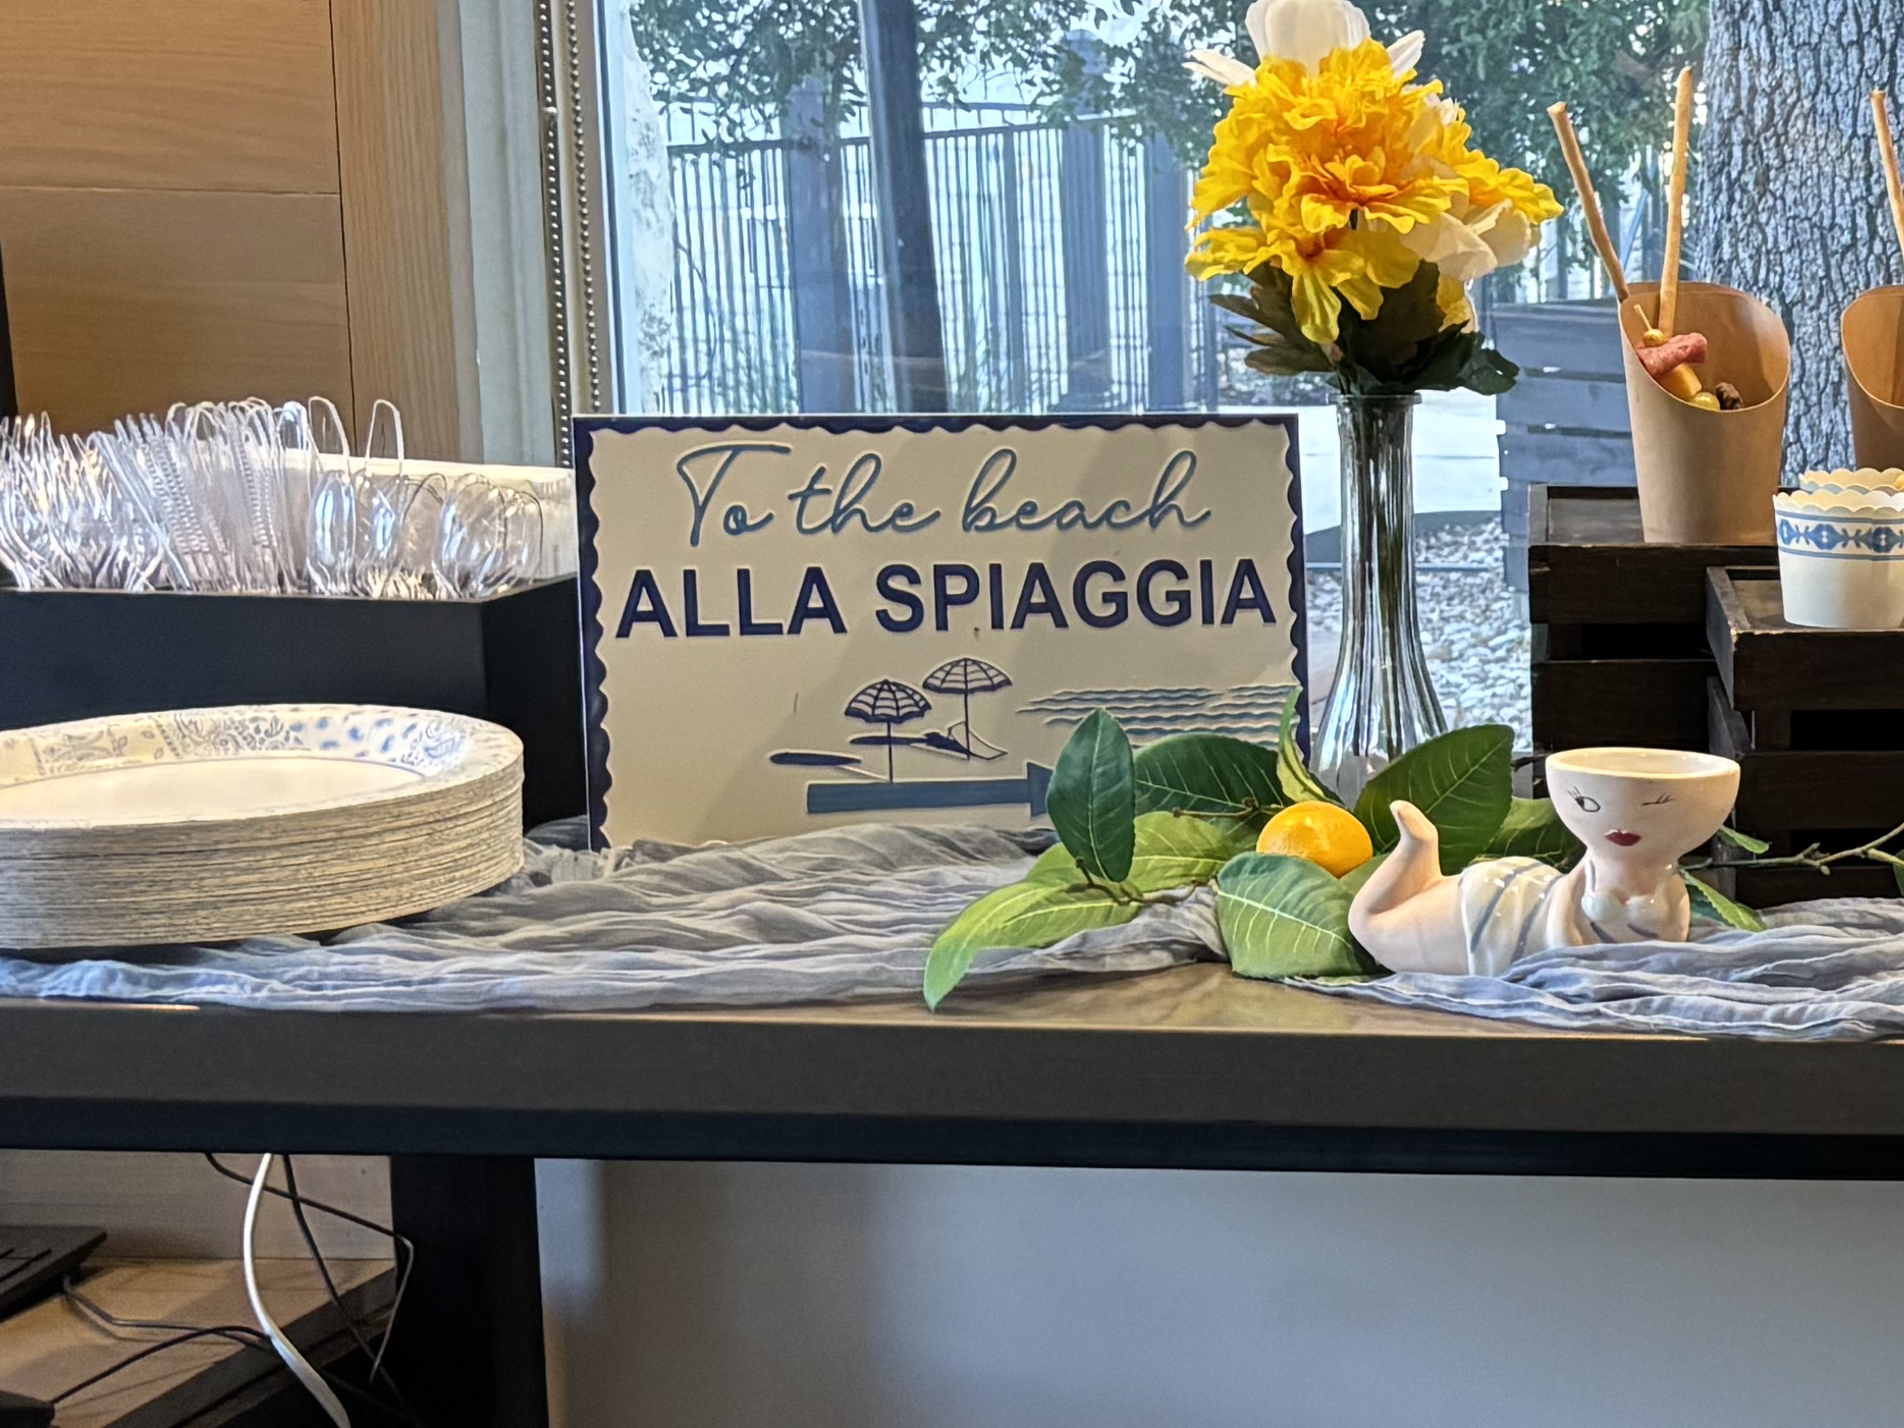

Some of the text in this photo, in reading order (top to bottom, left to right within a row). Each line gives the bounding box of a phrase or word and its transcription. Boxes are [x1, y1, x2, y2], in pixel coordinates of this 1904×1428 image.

[676, 443, 1212, 548] To the beach
[615, 558, 1277, 640] ALLA SPIAGGIA
